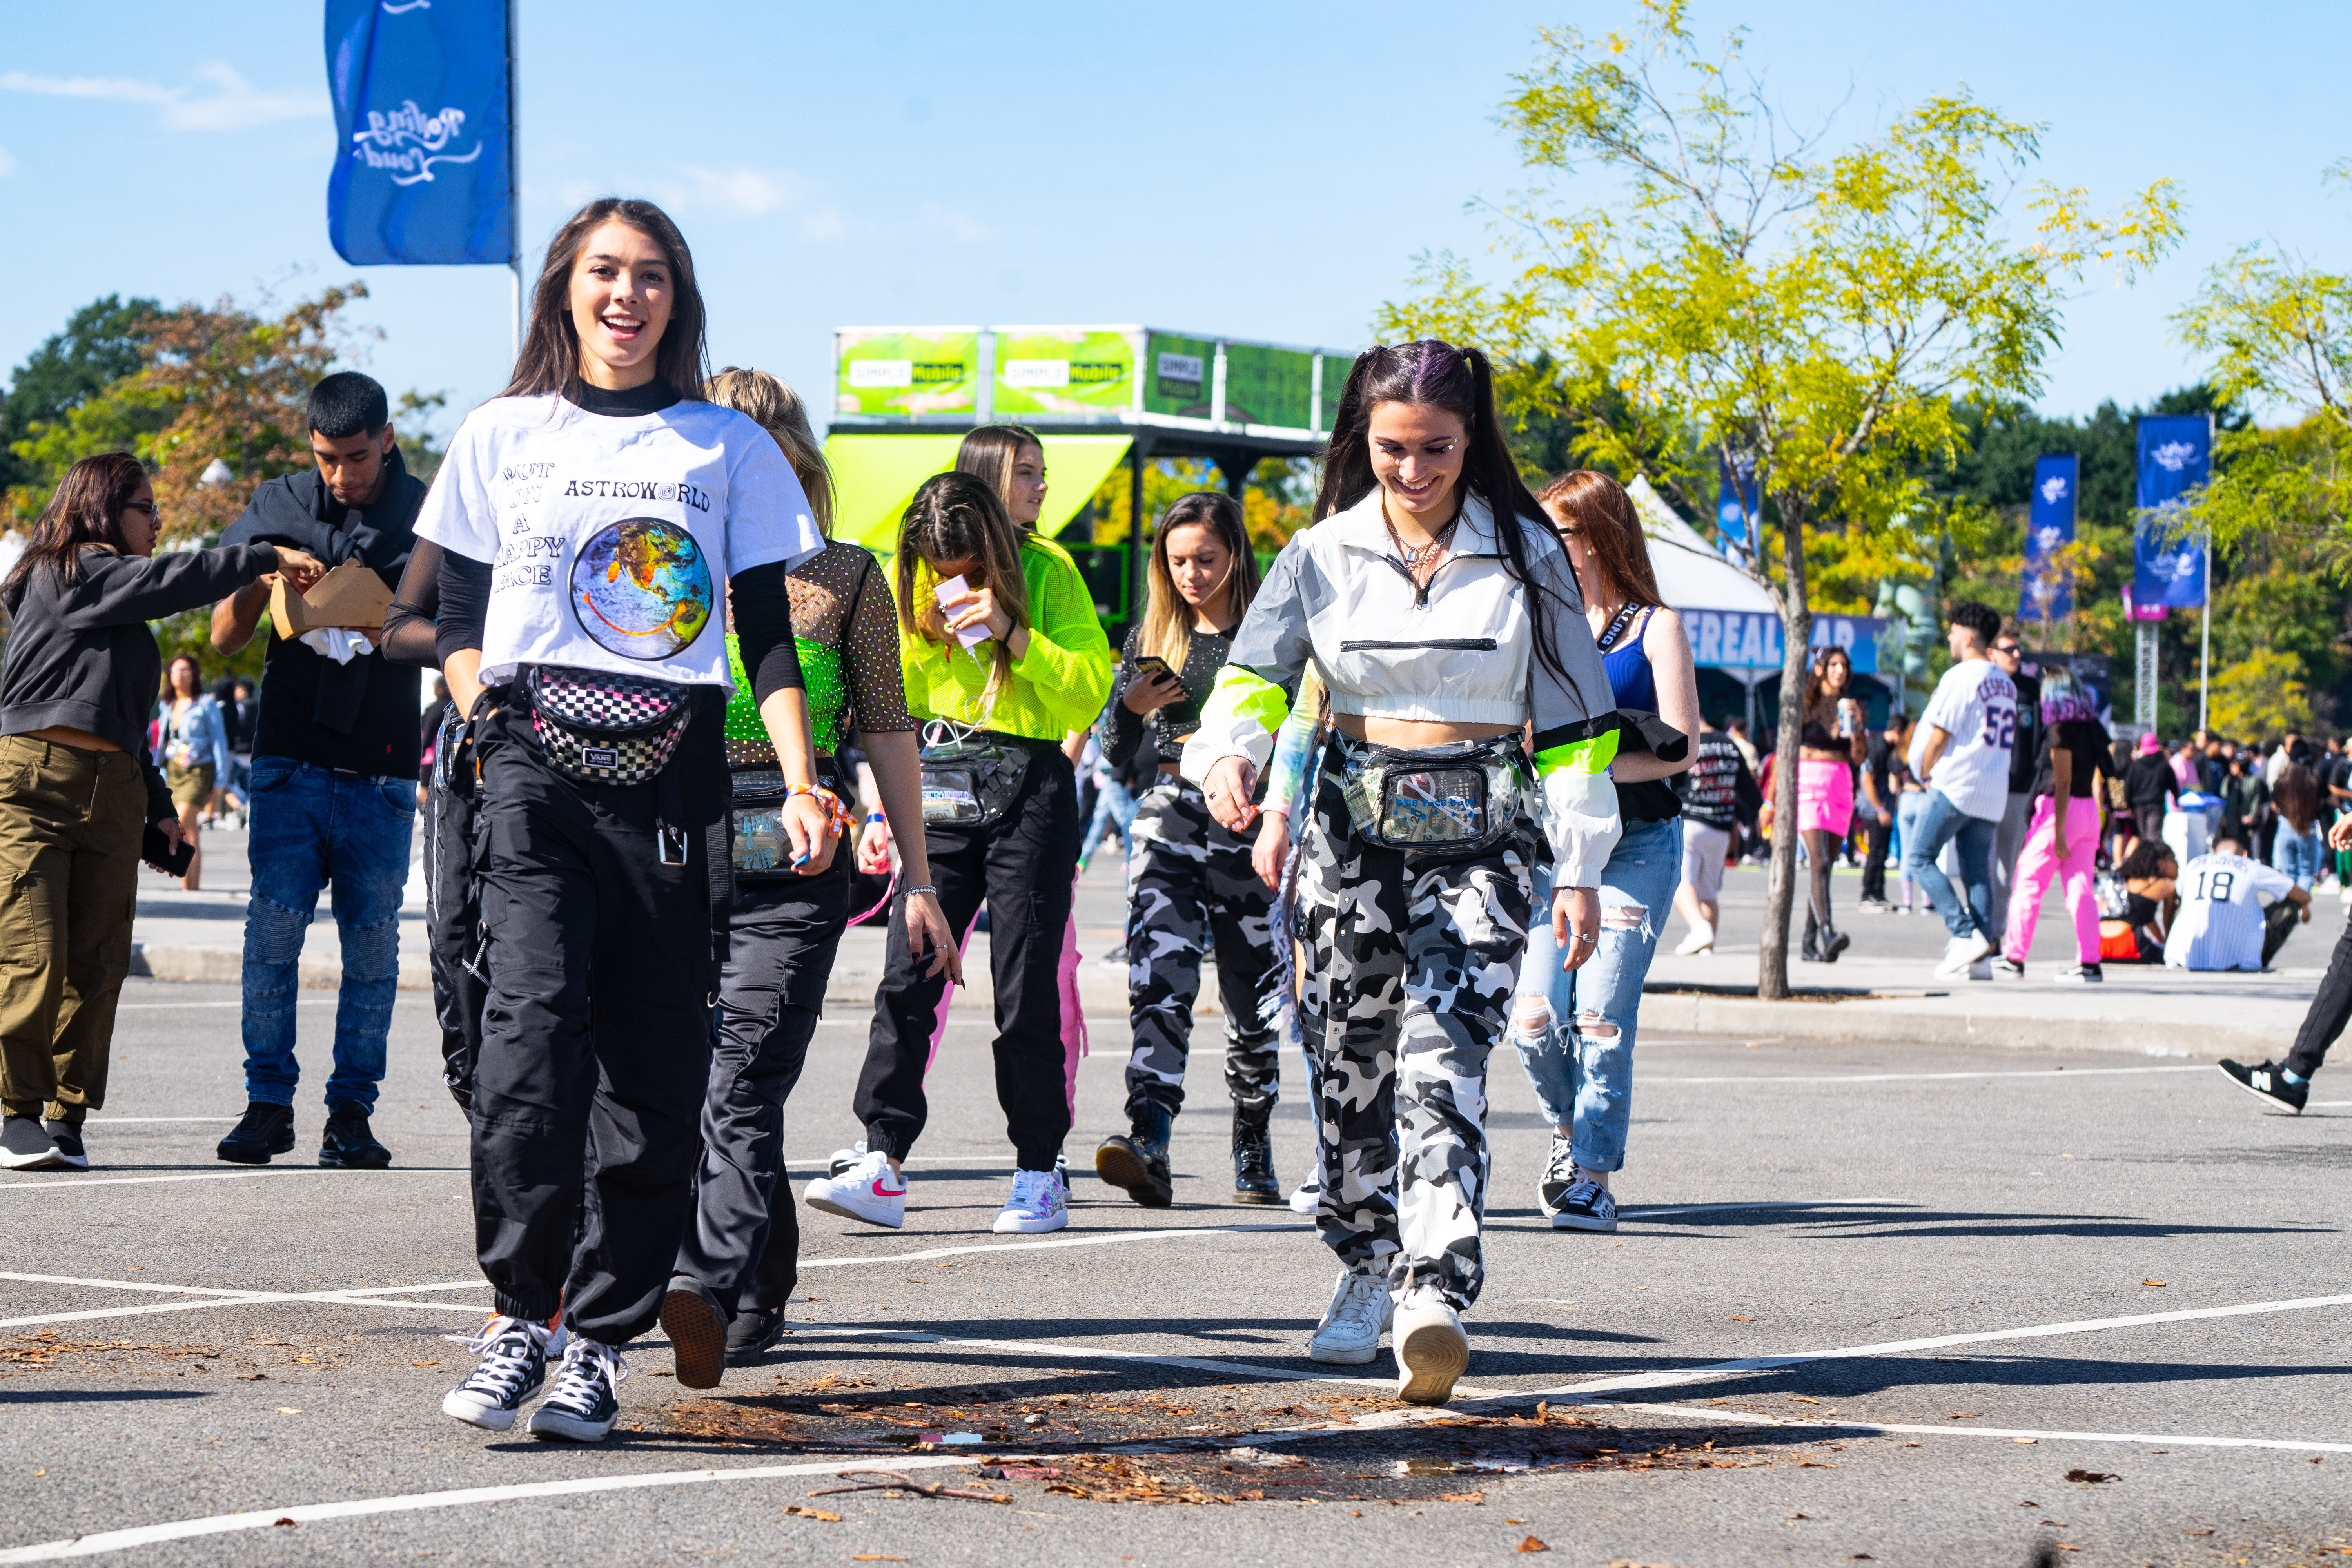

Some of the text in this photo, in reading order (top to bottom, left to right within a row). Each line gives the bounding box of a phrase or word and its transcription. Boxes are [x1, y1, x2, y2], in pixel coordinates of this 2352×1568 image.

[913, 365, 961, 380] Mobile
[1069, 365, 1120, 380] Mobile
[503, 463, 555, 486] PUT
[509, 483, 543, 508] ON
[564, 480, 710, 513] ASTROWORLD
[513, 513, 530, 534] A
[1601, 602, 1639, 645] OLLING
[1683, 610, 1782, 664] EREAL
[1983, 705, 2016, 749] 52
[590, 753, 612, 761] VANS
[1395, 797, 1475, 810] Blue Face Baby
[743, 814, 774, 834] LIFE'S
[744, 832, 755, 850] A
[742, 848, 773, 870] TRIP
[2194, 871, 2234, 903] 18
[2251, 1070, 2271, 1092] N
